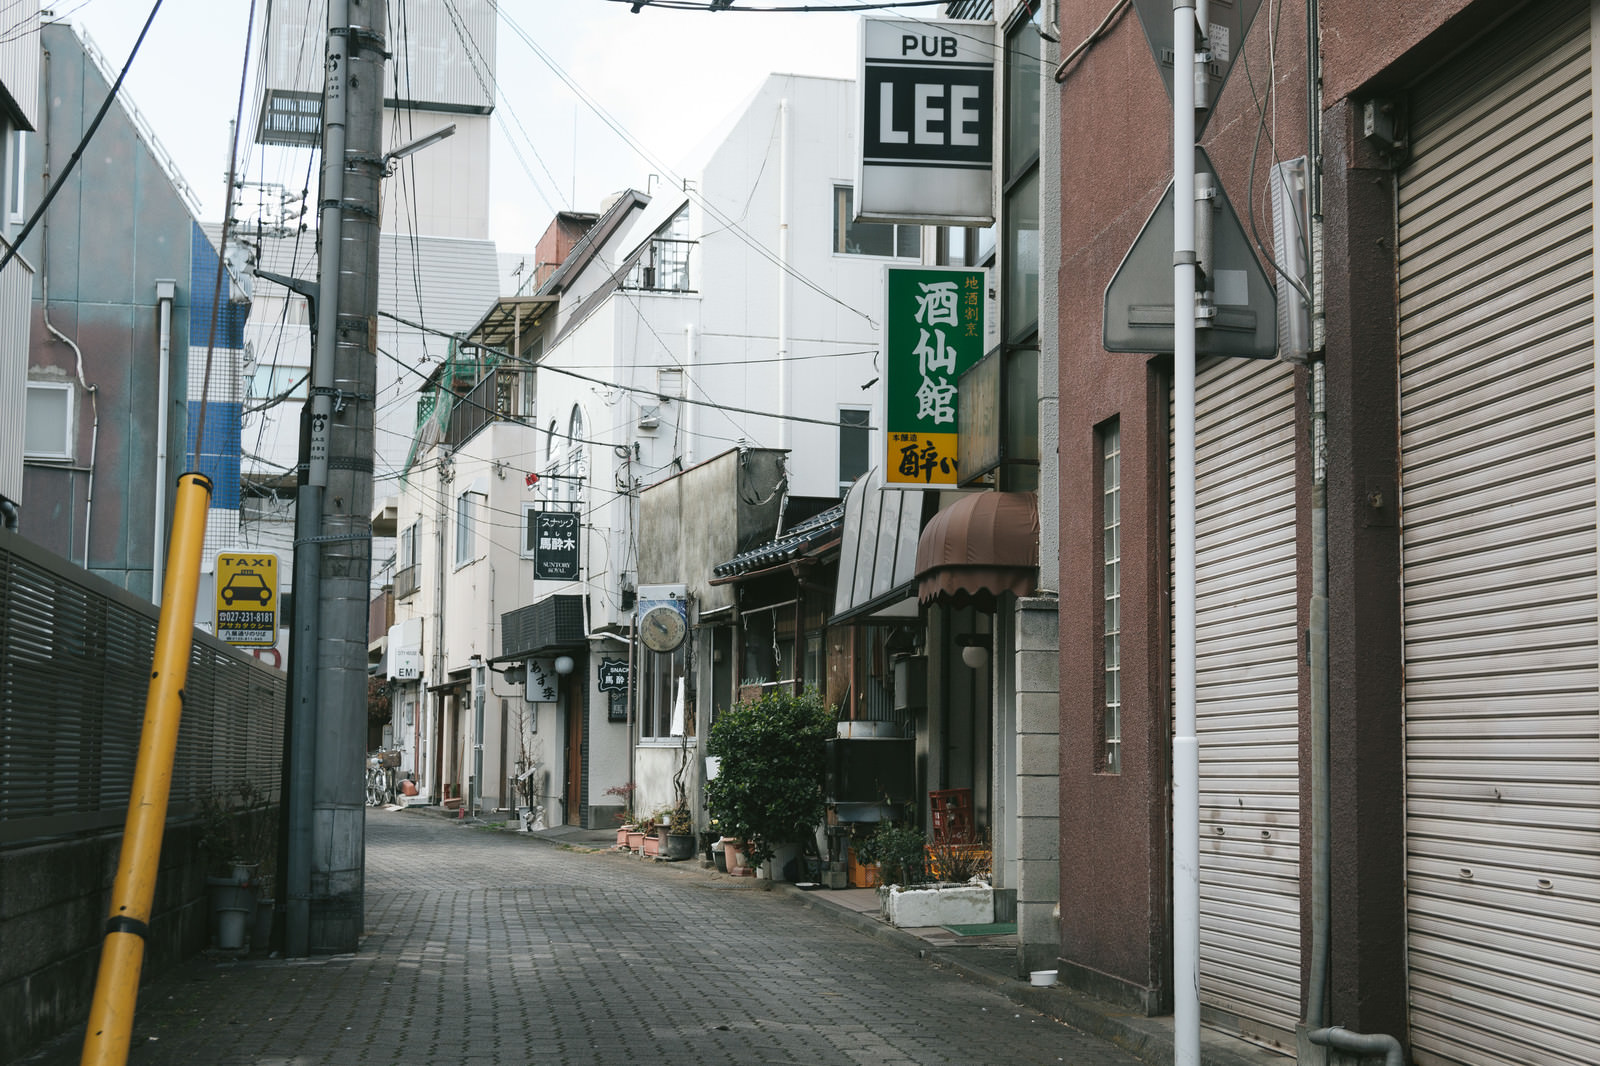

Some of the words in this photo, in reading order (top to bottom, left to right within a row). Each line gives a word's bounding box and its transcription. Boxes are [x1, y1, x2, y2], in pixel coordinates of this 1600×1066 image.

[902, 35, 957, 57] PUB
[880, 82, 979, 146] LEE
[964, 275, 979, 337] 地酒割烹
[912, 281, 958, 425] 酒仙館
[542, 517, 574, 527] スナック
[540, 537, 575, 551] 馬酔木
[221, 558, 272, 567] TAXI
[226, 611, 273, 622] 027-231-8181
